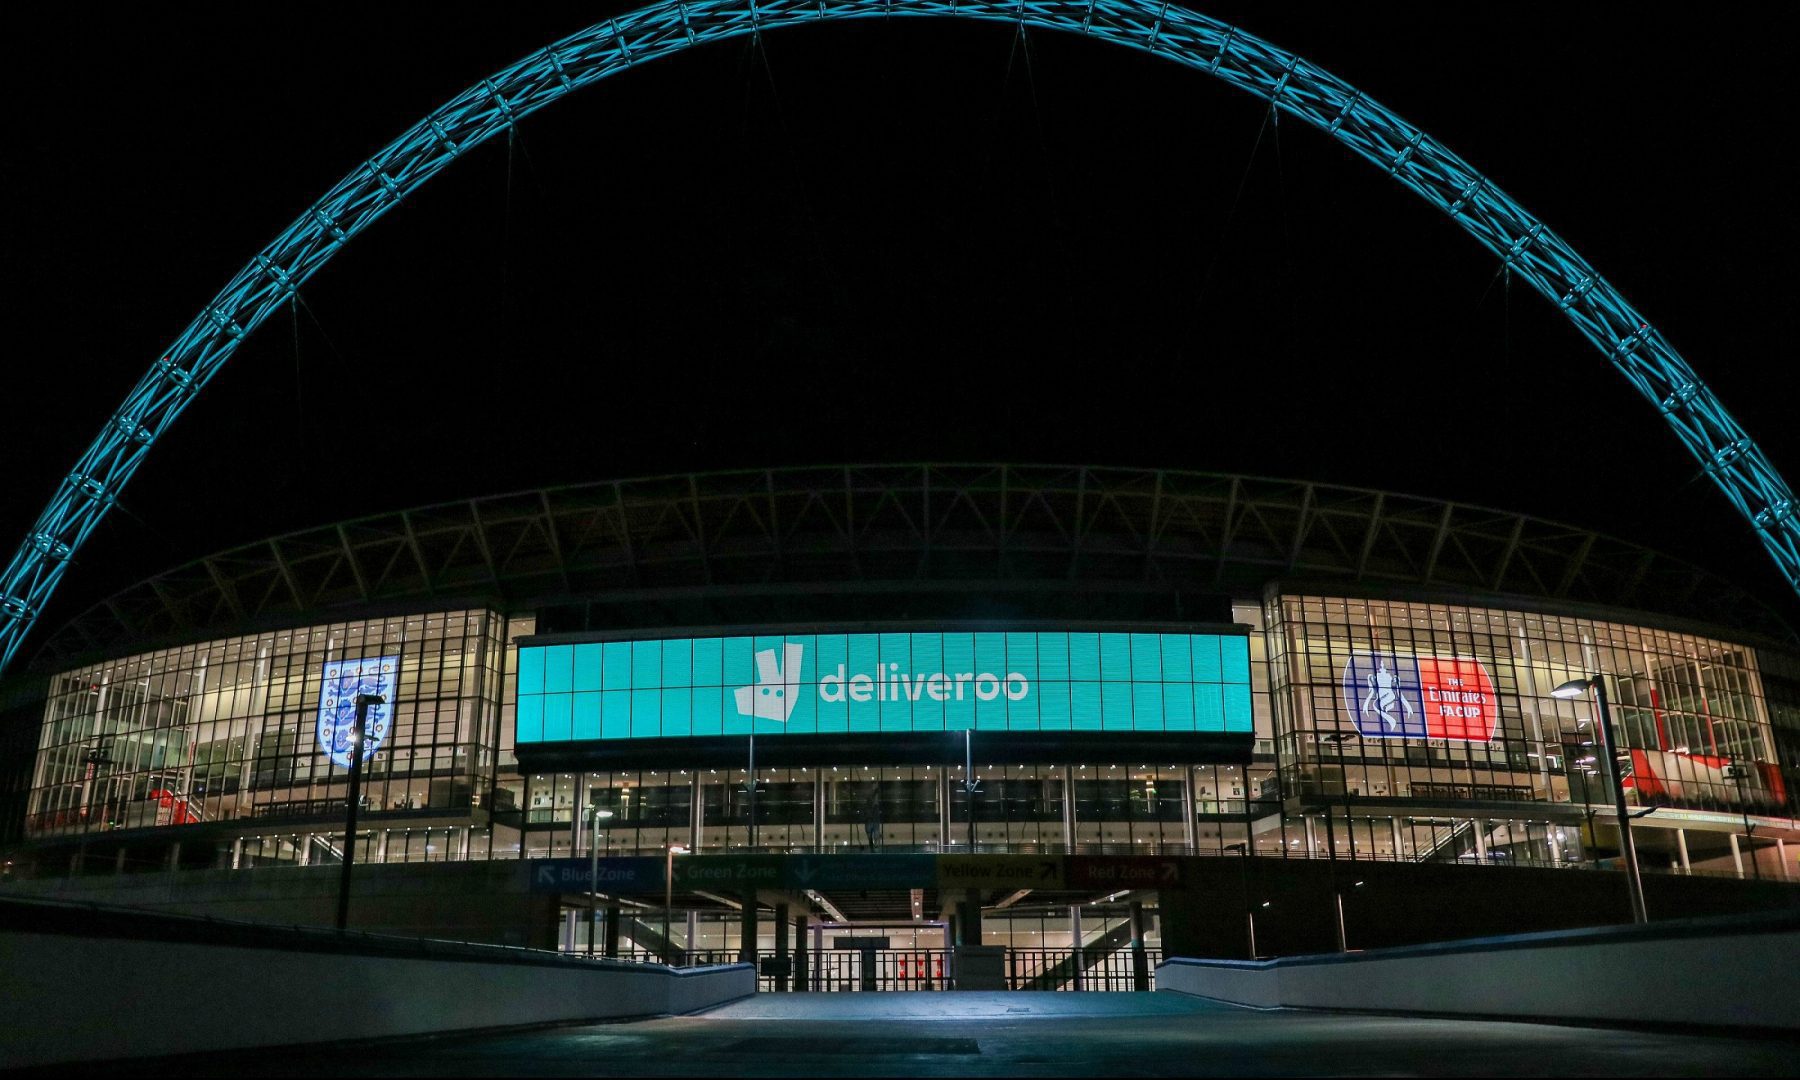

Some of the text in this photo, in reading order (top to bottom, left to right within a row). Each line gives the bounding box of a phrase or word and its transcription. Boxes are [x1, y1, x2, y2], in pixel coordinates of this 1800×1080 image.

[819, 663, 1029, 703] deliveroo
[1448, 678, 1464, 687] THE
[1428, 686, 1486, 704] Emirates
[1440, 705, 1480, 718] FA CUP
[561, 867, 636, 881] Blue Zone
[687, 864, 777, 880] Green Zone
[943, 863, 991, 878] Yellow
[996, 863, 1033, 878] Zone
[1088, 865, 1156, 879] Red Zone
